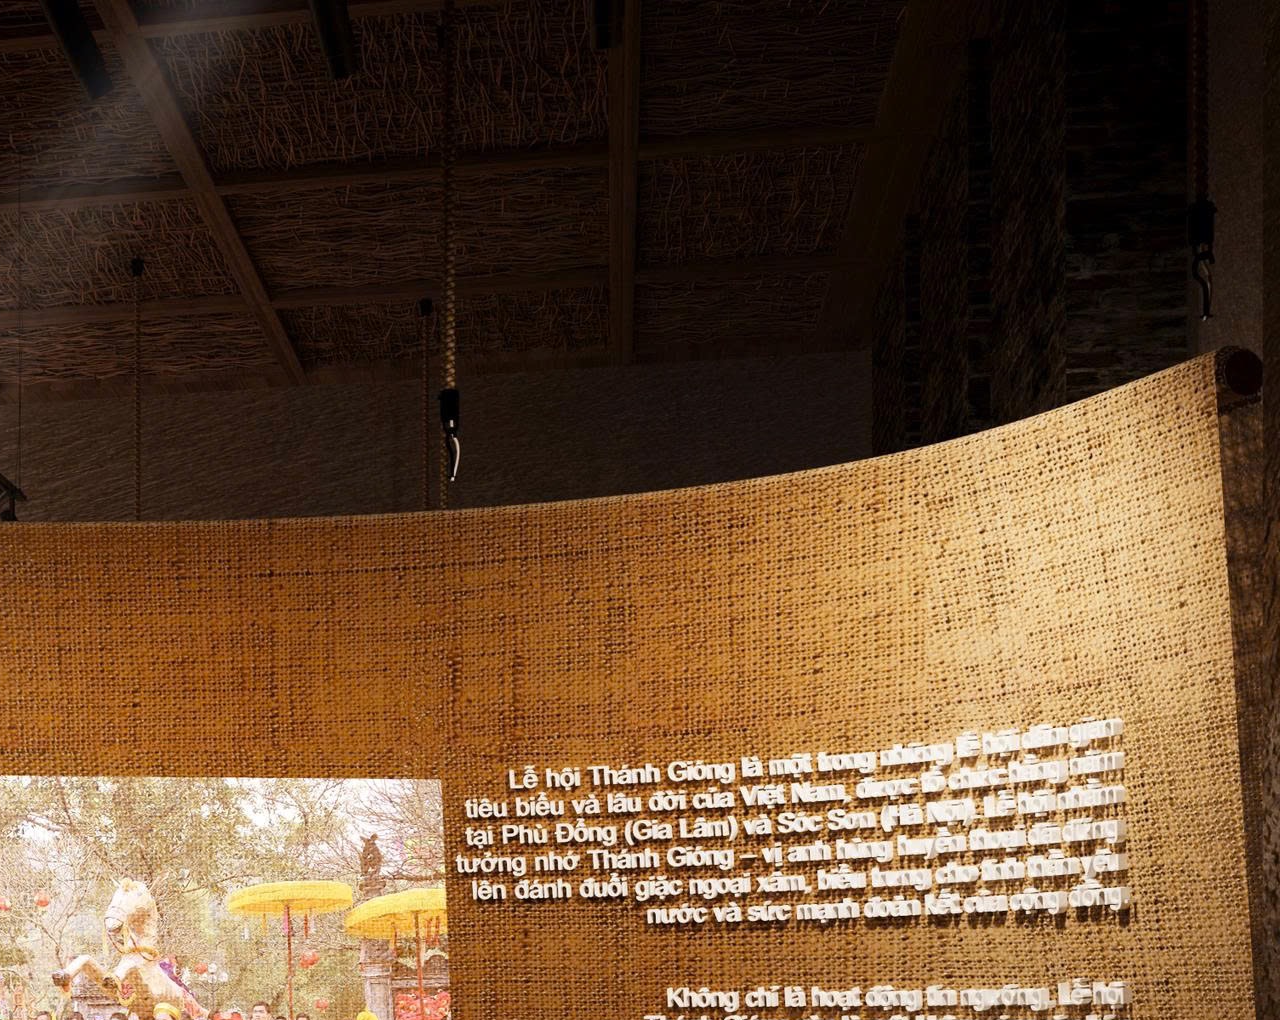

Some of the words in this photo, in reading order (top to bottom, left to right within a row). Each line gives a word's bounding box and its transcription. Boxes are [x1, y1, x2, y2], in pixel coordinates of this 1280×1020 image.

[508, 764, 538, 789] Lễ
[546, 767, 581, 791] hội
[588, 763, 660, 786] Thánh
[667, 760, 736, 785] Gióng
[741, 755, 763, 778] là
[768, 752, 814, 778] một
[465, 798, 507, 819] tiêu
[515, 791, 564, 817] biểu
[572, 793, 600, 815] và
[607, 792, 642, 814] lâu
[648, 789, 686, 812] đời
[692, 786, 735, 810] của
[739, 783, 786, 810] Việt
[791, 780, 851, 805] Nam,
[465, 826, 493, 850] tại
[502, 823, 548, 845] Phù
[554, 817, 618, 847] Đổng
[624, 819, 673, 846] (Gia
[679, 815, 738, 841] Lâm)
[742, 813, 772, 836] và
[777, 810, 824, 834] Sóc
[827, 808, 877, 831] Sơn
[456, 851, 526, 877] tưởng
[534, 850, 580, 872] nhớ
[587, 847, 660, 870] Thánh
[666, 845, 735, 871] Gióng
[761, 846, 784, 867] vị
[787, 839, 832, 863] anh
[471, 879, 507, 901] lên
[514, 879, 572, 900] đánh
[580, 872, 628, 898] đuổi
[635, 875, 683, 902] giặc
[689, 871, 751, 900] ngoại
[756, 870, 812, 894] xâm,
[646, 902, 708, 924] nước
[713, 901, 741, 923] và
[747, 899, 792, 922] sức
[796, 897, 861, 924] mạnh
[666, 986, 739, 1013] Không
[784, 985, 806, 1008] là
[811, 985, 862, 1011] hoạt
[865, 984, 924, 1013] động
